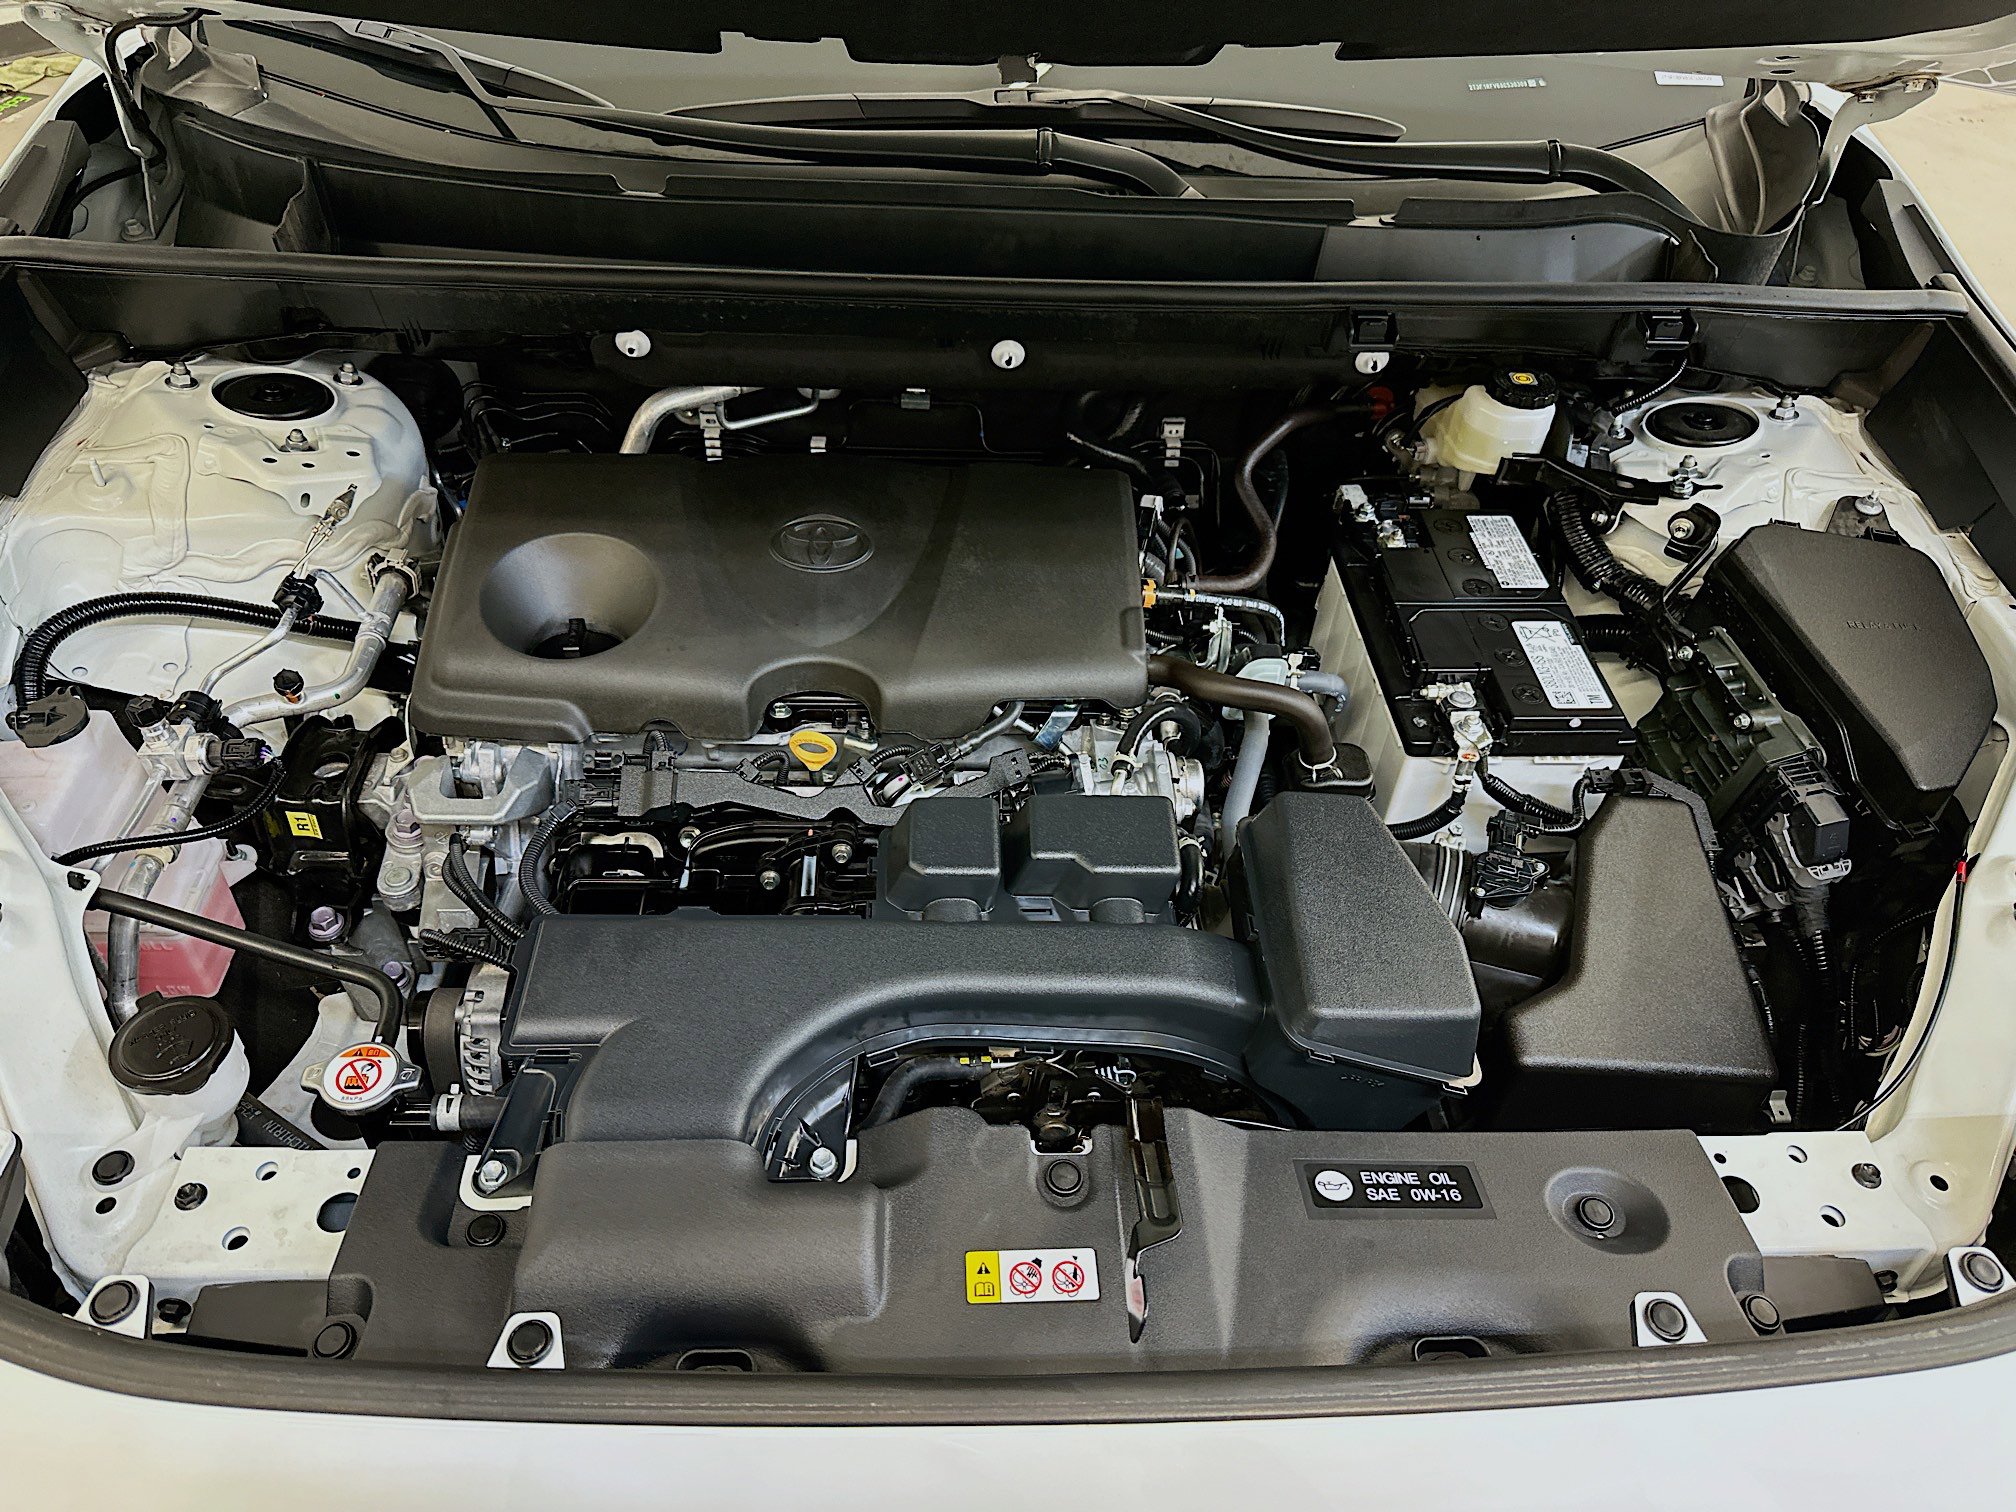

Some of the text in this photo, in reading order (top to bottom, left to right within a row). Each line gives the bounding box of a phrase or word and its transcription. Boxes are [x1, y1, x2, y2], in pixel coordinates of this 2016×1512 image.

[294, 817, 311, 831] R1
[1360, 1171, 1457, 1186] ENGINE OIL
[1365, 1188, 1462, 1202] SAE 0W-16
